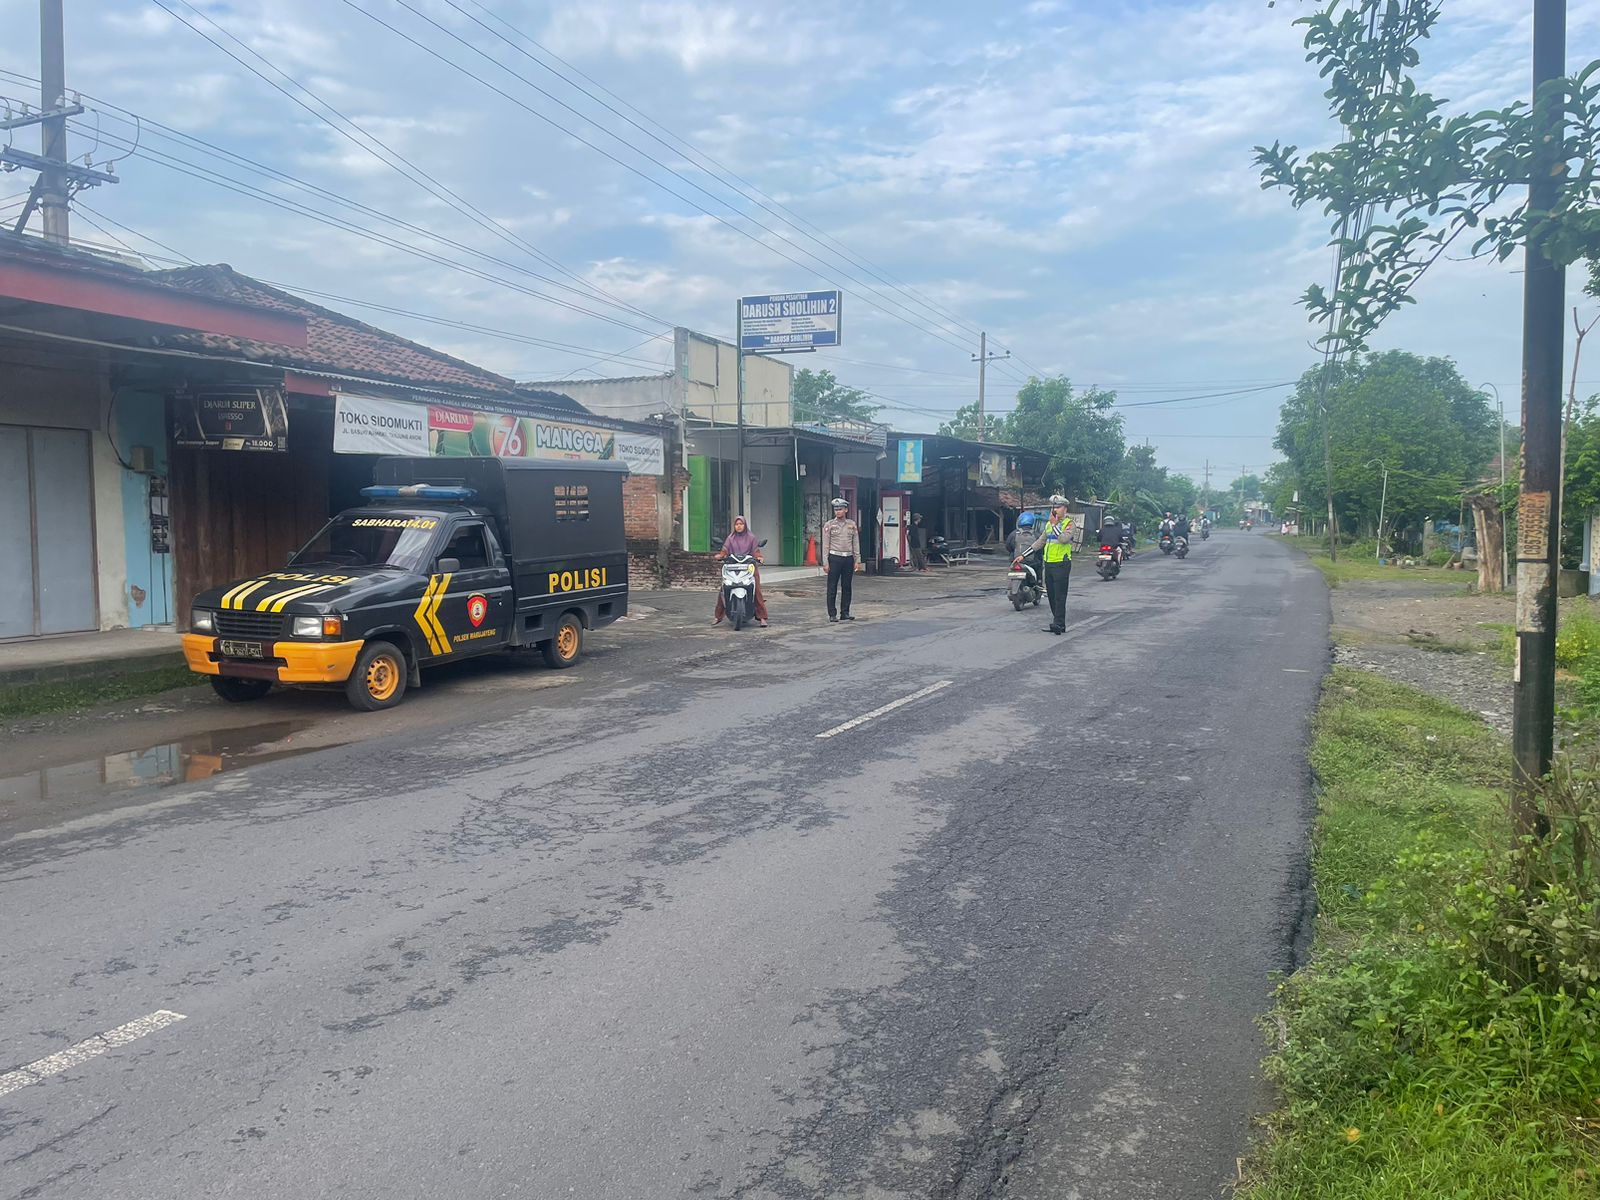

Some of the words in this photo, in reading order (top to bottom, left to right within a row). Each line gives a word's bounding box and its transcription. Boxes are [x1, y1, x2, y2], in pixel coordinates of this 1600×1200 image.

[743, 303, 780, 318] DARUSH
[783, 300, 827, 316] SHOLIHIN
[829, 299, 836, 313] 2
[770, 335, 790, 343] DARUSH
[232, 400, 256, 409] SUPER
[340, 411, 368, 426] TOKO
[370, 415, 423, 431] SIDOMUKTI
[435, 408, 469, 425] DJARUM
[494, 417, 522, 457] 76
[536, 424, 604, 453] MANGGA
[618, 444, 633, 454] TOKO
[257, 573, 360, 585] POLISI
[549, 567, 607, 593] POLISI
[453, 632, 469, 643] POLSEK
